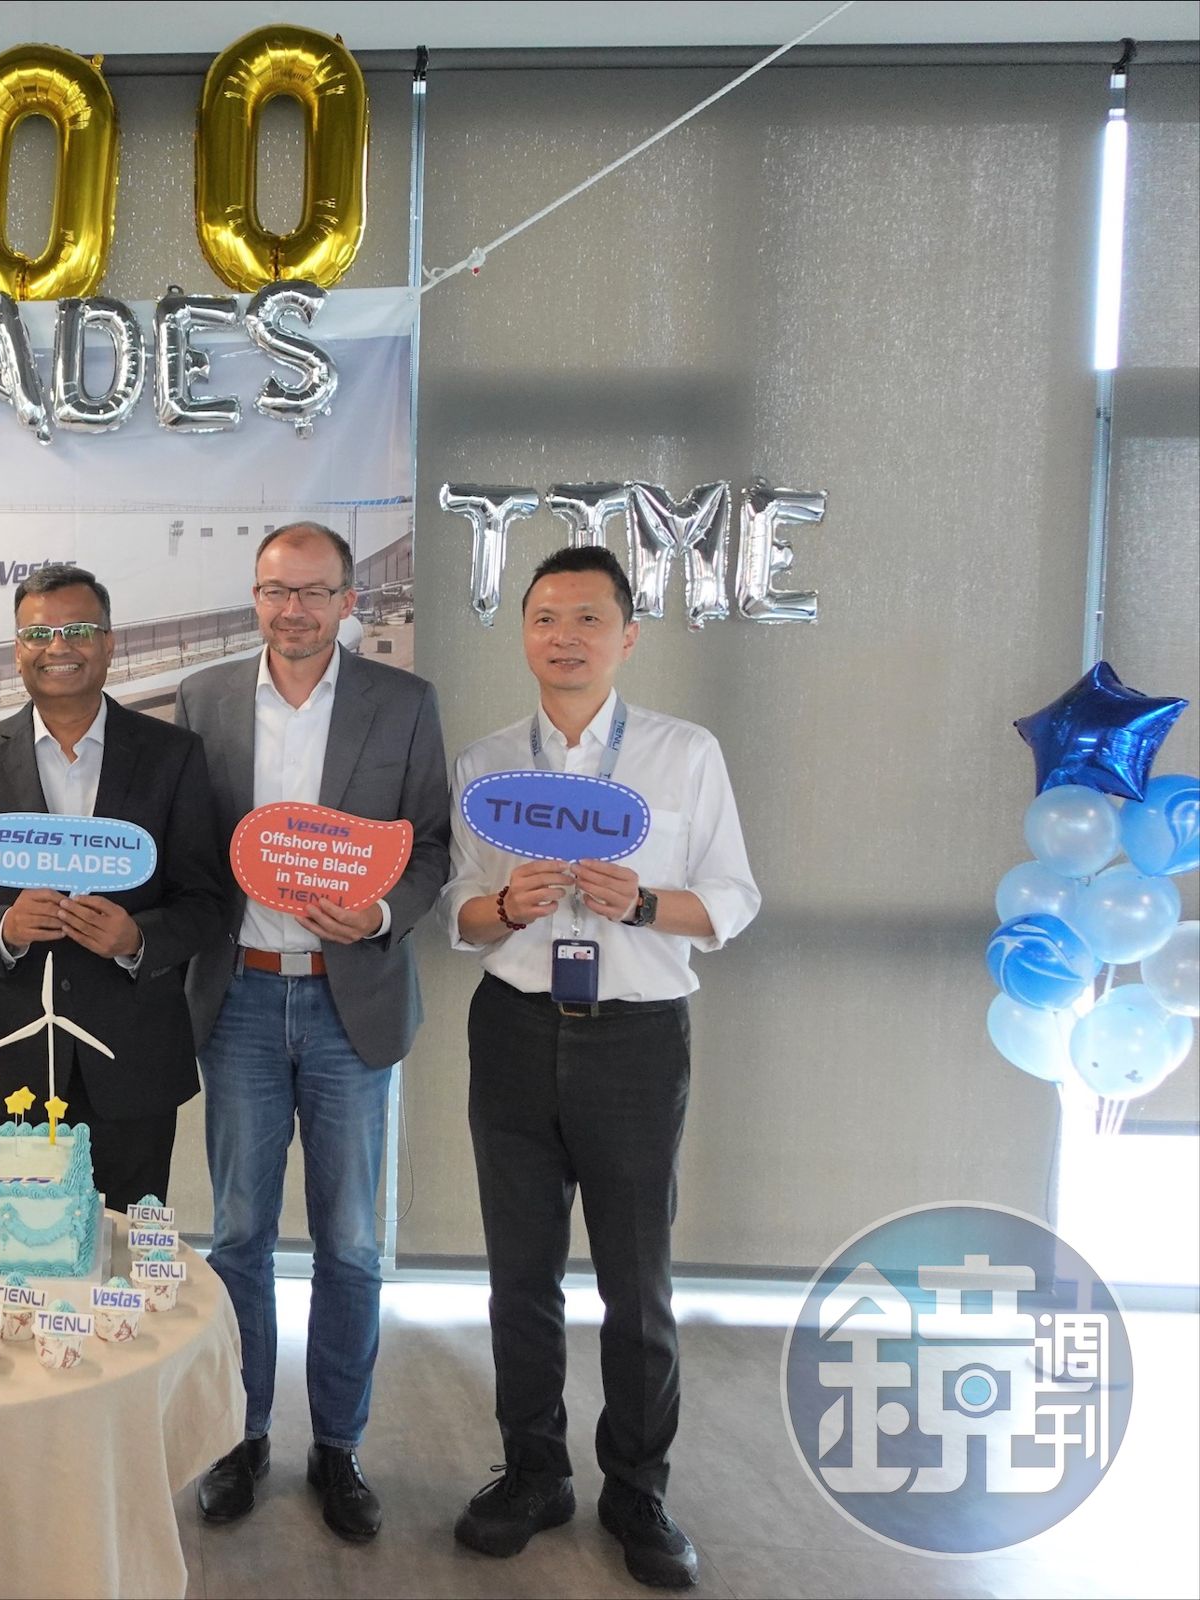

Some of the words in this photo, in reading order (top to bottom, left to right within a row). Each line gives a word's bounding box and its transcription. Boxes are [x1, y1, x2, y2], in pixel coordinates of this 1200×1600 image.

[287, 817, 350, 837] Vestas
[485, 797, 631, 838] TIENLI
[69, 833, 140, 850] TIENLI
[260, 831, 328, 852] Offshore
[332, 840, 373, 858] Wind
[36, 852, 132, 875] BLADES
[260, 849, 319, 868] Turbine
[322, 858, 367, 875] Blade
[276, 869, 290, 883] in
[295, 871, 349, 891] Taiwan
[278, 887, 344, 907] TIENI
[129, 1206, 173, 1222] TIENLI
[129, 1231, 175, 1247] Vestas
[135, 1263, 184, 1280] TIENLI
[93, 1288, 142, 1309] Vestas
[38, 1313, 92, 1334] TIENLI
